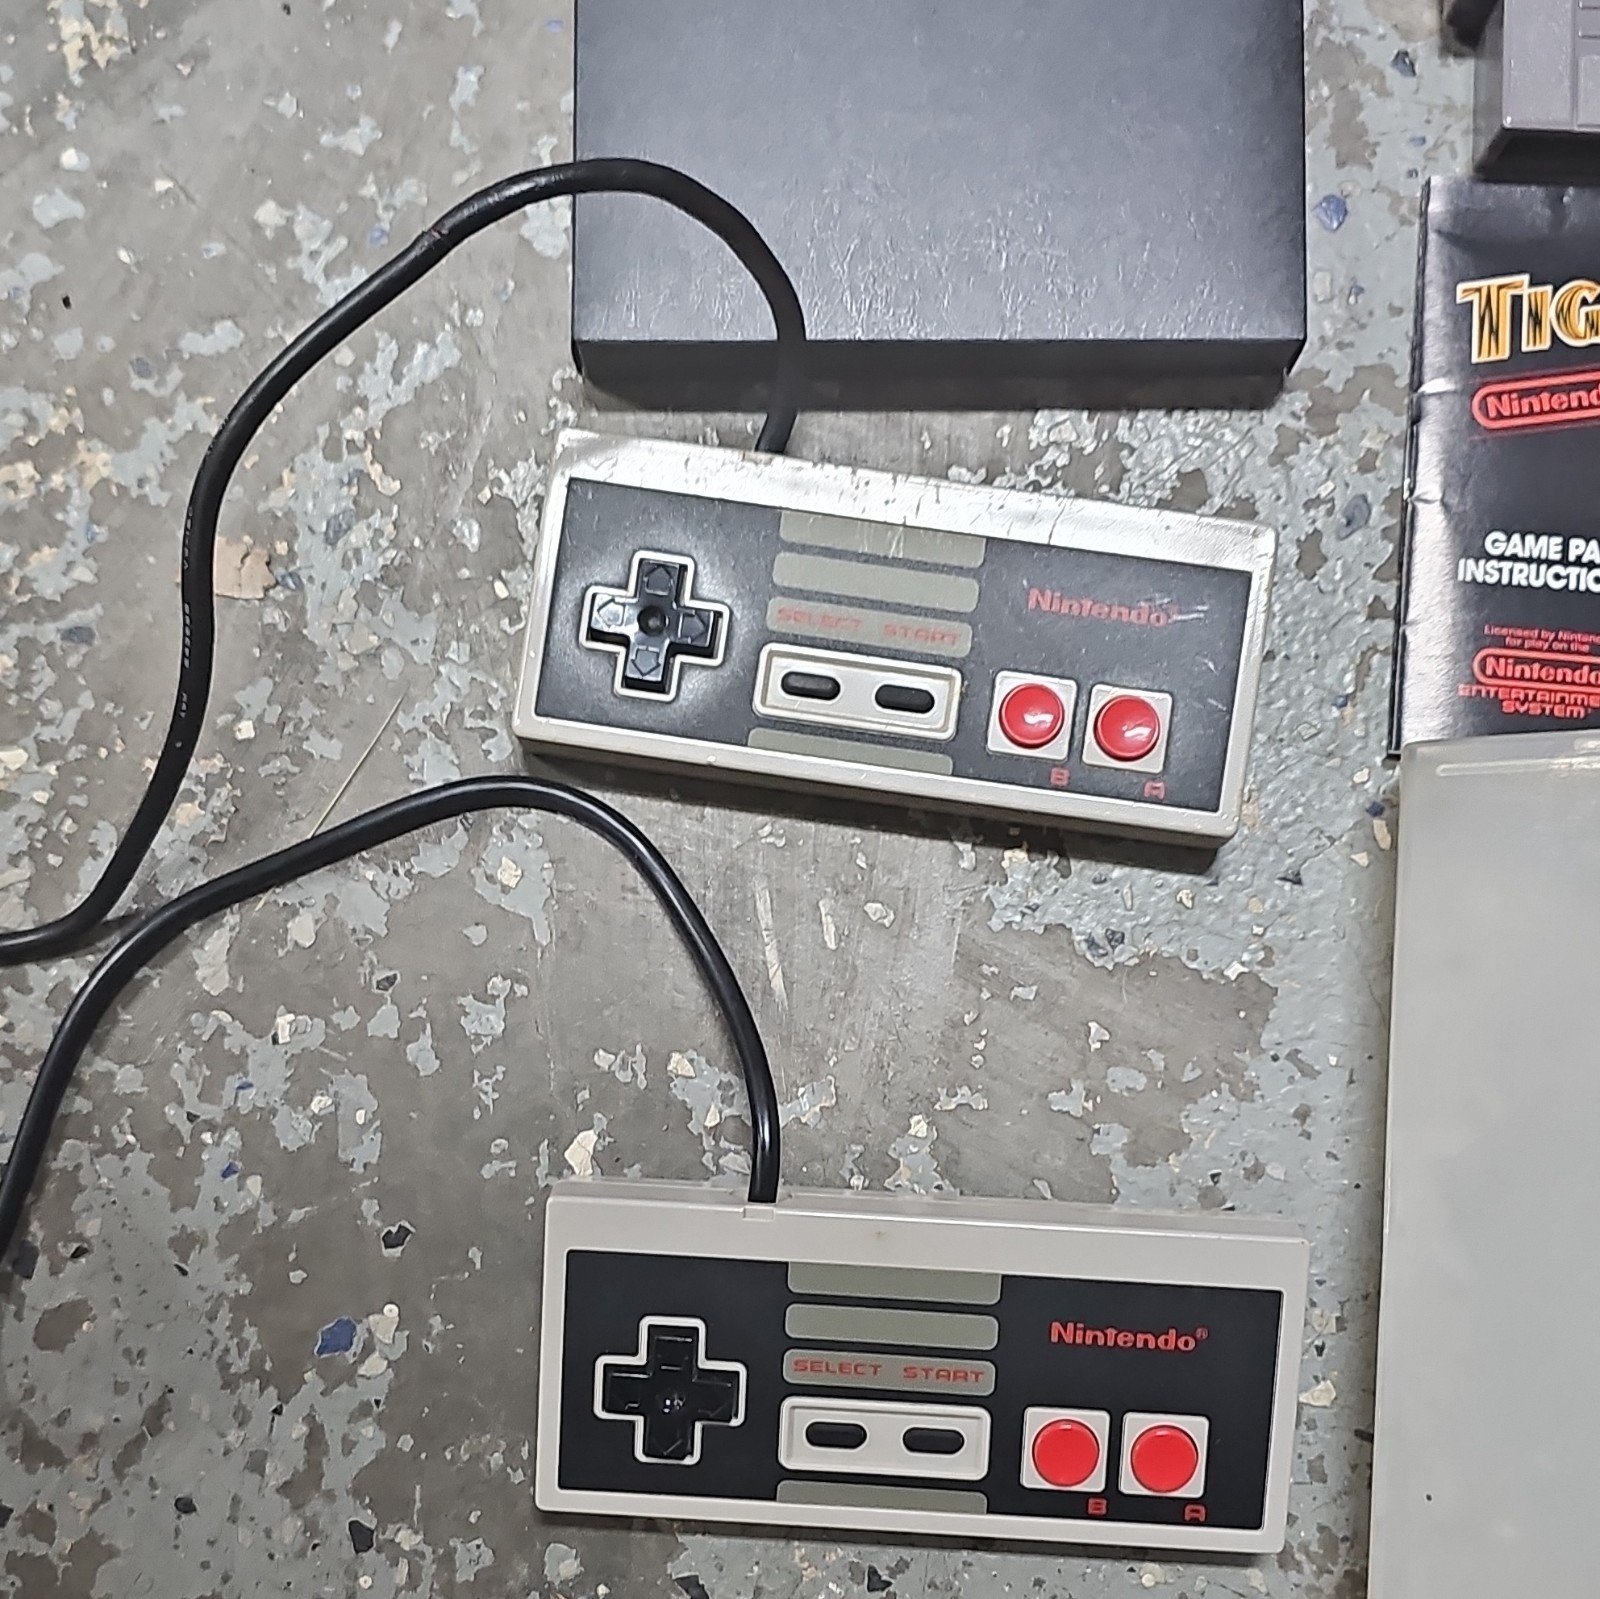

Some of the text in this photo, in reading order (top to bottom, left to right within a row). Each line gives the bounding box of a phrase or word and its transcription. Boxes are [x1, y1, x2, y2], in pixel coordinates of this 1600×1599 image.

[1485, 531, 1600, 564] GAME PA
[1028, 587, 1170, 627] Nintendo
[777, 606, 962, 648] SELECT START
[1484, 624, 1539, 638] Licensed
[1541, 630, 1555, 641] by
[1506, 637, 1590, 652] for play on the
[1502, 700, 1586, 718] SYSTEM
[1051, 768, 1164, 800] B A
[793, 1359, 984, 1384] SELECT START
[1088, 1498, 1206, 1523] B A
